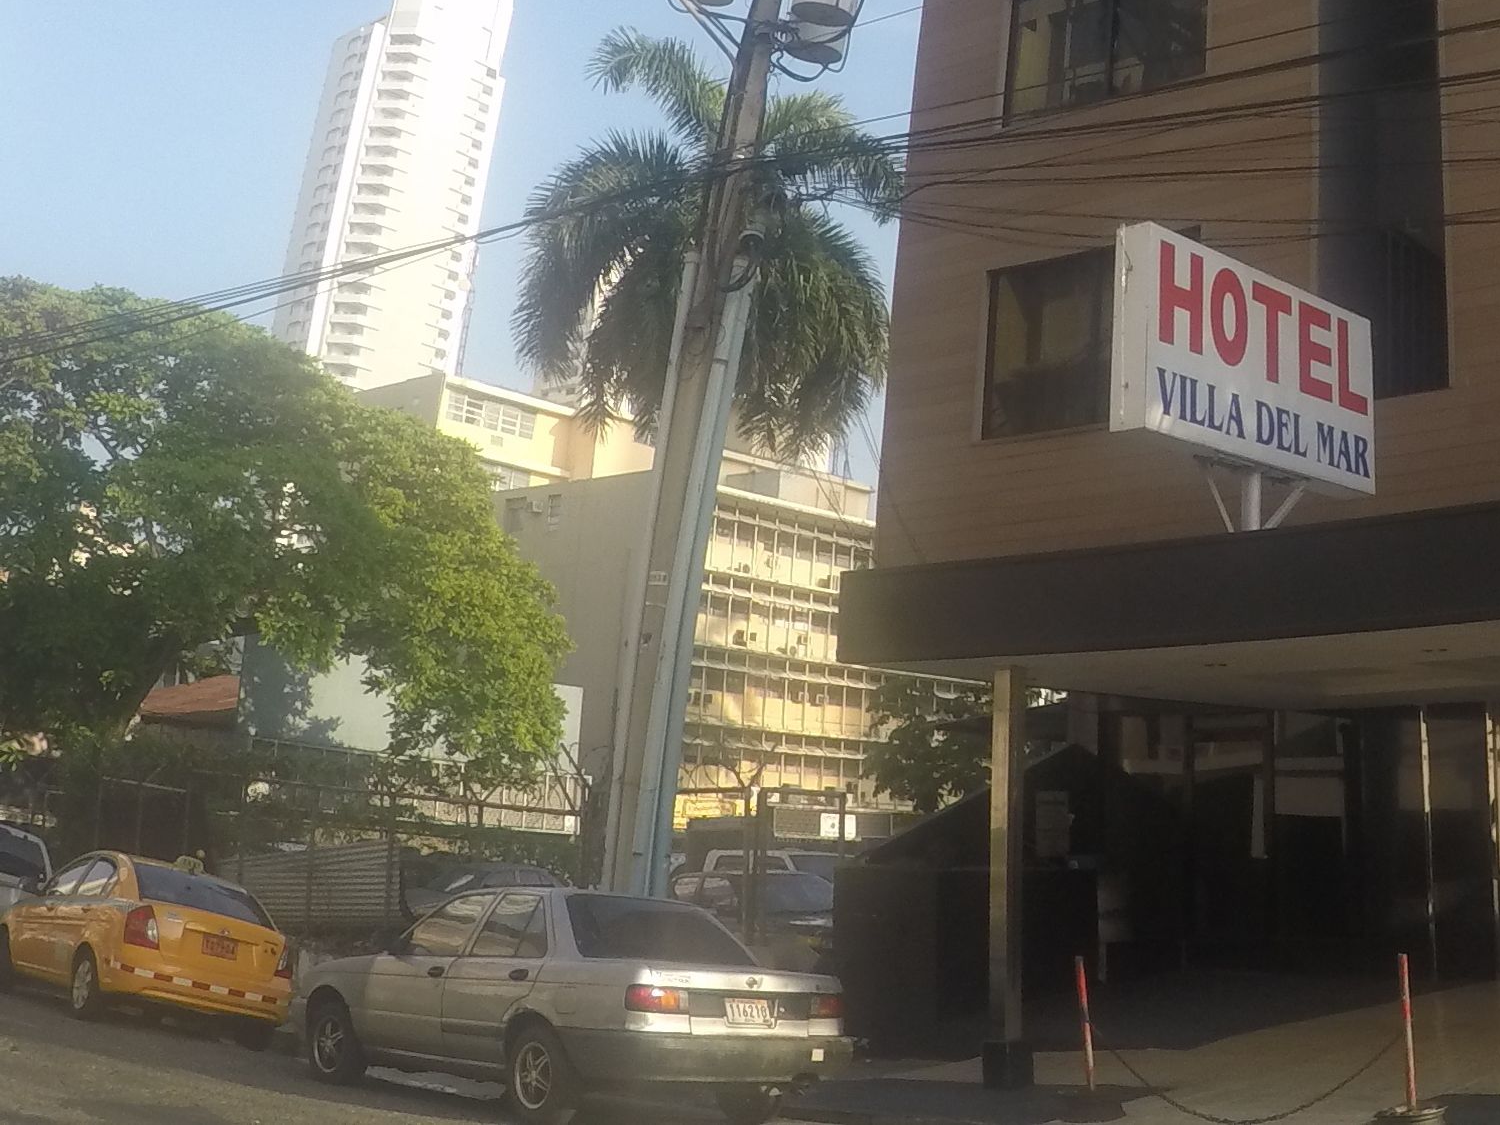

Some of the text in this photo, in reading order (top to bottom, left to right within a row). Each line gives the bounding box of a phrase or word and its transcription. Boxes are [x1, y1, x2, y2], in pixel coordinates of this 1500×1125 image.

[1158, 239, 1369, 416] HOTEL
[1156, 366, 1371, 479] VILLA DEL MAR
